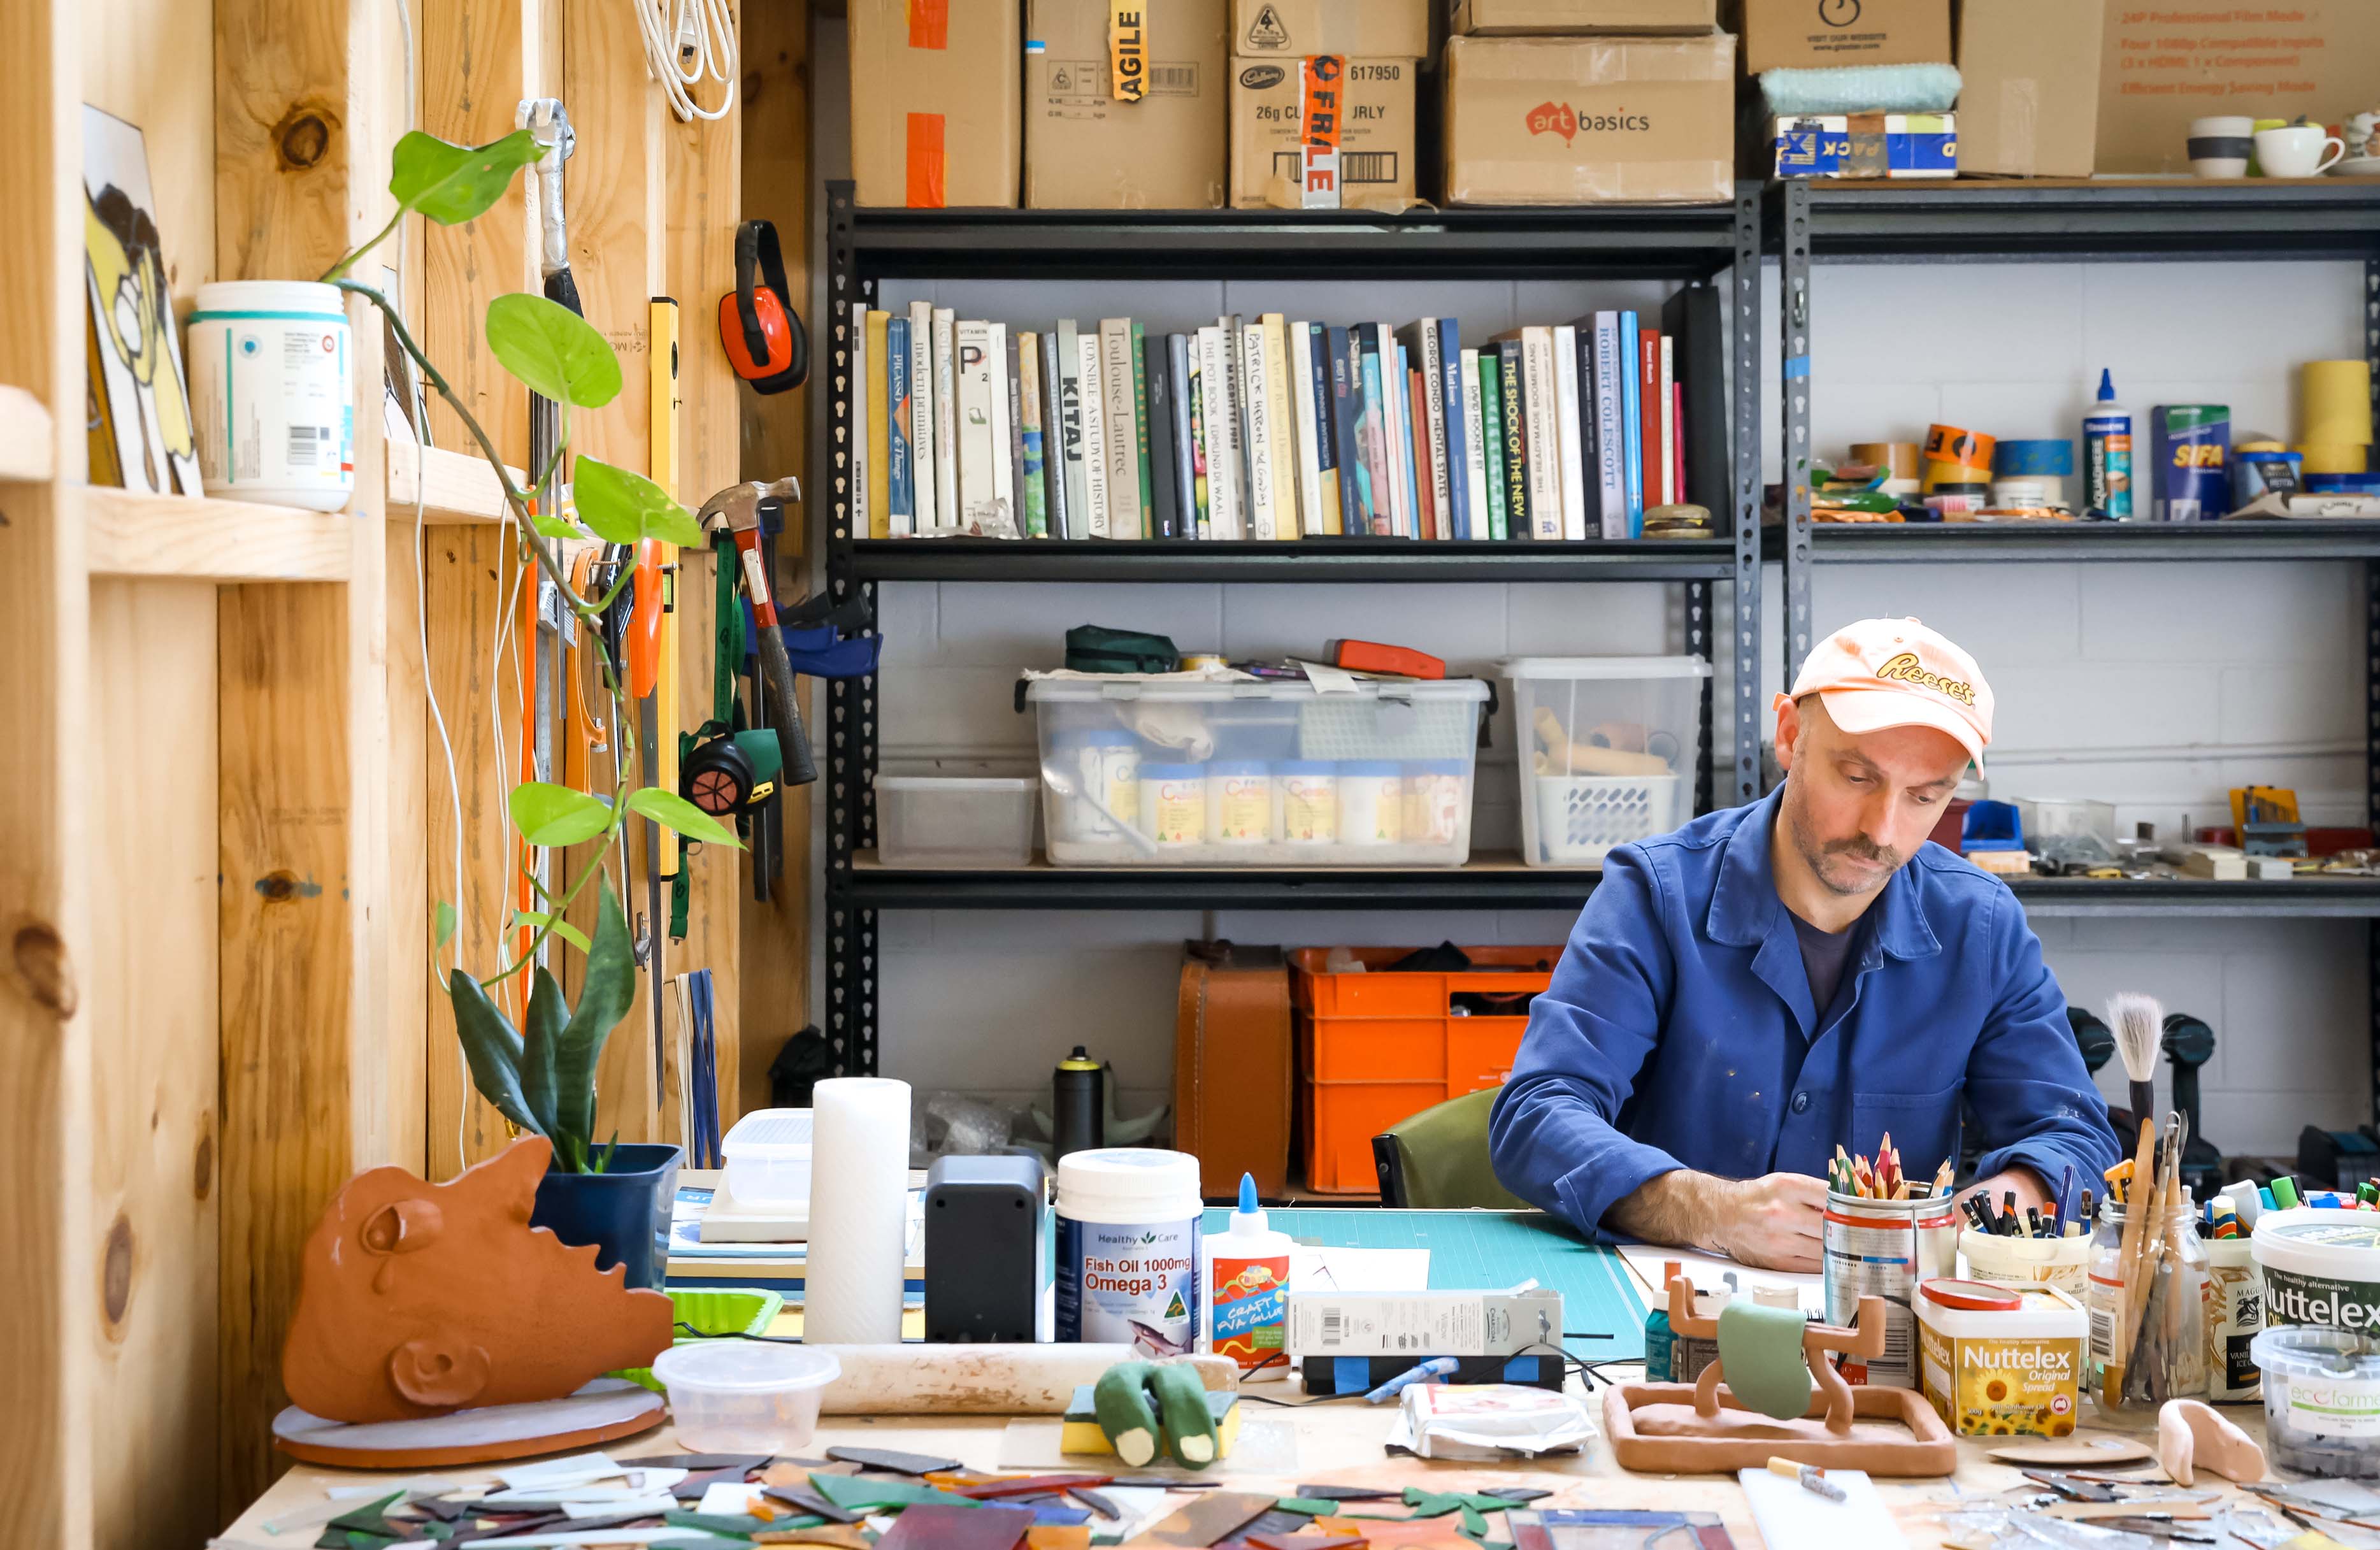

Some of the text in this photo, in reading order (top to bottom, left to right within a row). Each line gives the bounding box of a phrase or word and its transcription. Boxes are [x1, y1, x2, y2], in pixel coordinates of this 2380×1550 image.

[2150, 11, 2232, 24] Professional
[2233, 10, 2263, 22] Film
[2265, 10, 2305, 22] Mode
[1850, 32, 1886, 41] WEBSITE
[2121, 38, 2151, 50] Four
[2199, 37, 2278, 50] Compatible
[2281, 37, 2325, 49] Inputs
[1350, 66, 1400, 80] 617950
[2120, 81, 2316, 96] Efficient Energy Saving Mode
[1256, 106, 1280, 122] 26g
[1534, 106, 1650, 131] art basics
[1823, 140, 1879, 157] PACK
[959, 346, 982, 375] P
[1426, 326, 1438, 369] GEORGE
[1084, 340, 1097, 397] TOYNBEE
[1248, 333, 1263, 395] PATRICK
[1335, 358, 1347, 398] every day
[1503, 361, 1517, 388] THE
[913, 342, 929, 460] modern primitives
[1108, 327, 1129, 478] Toulouse-Lautrec
[1226, 363, 1238, 424] MAGRITTE
[1430, 373, 1441, 413] CONDO
[1471, 385, 1480, 412] DAVID
[891, 354, 904, 480] PICASSO & Things
[1063, 377, 1082, 462] KITAJ
[1252, 401, 1265, 444] HERON
[1505, 389, 1521, 435] SHOCK
[1529, 343, 1544, 494] THE READYMADE BOOMERANG
[1599, 327, 1616, 490] ROBERT COLESCOTT
[1089, 415, 1101, 457] STUDY
[1206, 341, 1226, 517] THE POT BOOK EDMUND DE WAAL
[1433, 417, 1445, 459] MENTAL
[1472, 414, 1482, 456] HOCKNEY
[1508, 436, 1522, 455] OF
[2172, 443, 2224, 468] SIFA
[1091, 459, 1102, 476] OF
[1436, 463, 1448, 499] STATES
[1510, 457, 1524, 482] THE
[2091, 438, 2105, 510] AQUADHERE
[1092, 478, 1106, 531] HISTORY
[1511, 484, 1525, 517] NEW
[1876, 652, 1975, 706] Reese's
[1098, 1233, 1179, 1245] Healthy Care
[1085, 1257, 1191, 1273] Fish Oil 1000mg
[1085, 1273, 1167, 1296] Omega 3
[2273, 1270, 2350, 1292] The healthy alternative
[1228, 1296, 1273, 1320] CRAFT
[2262, 1276, 2380, 1329] Nuttelex
[1217, 1305, 1283, 1333] PVA GLUE
[1921, 1327, 1951, 1368] Nuttelex
[1964, 1345, 2070, 1370] Nuttelex
[2230, 1351, 2251, 1360] VANIL
[2028, 1370, 2070, 1383] Original
[2236, 1360, 2246, 1368] ICE
[2023, 1382, 2055, 1394] Spread
[1967, 1407, 1982, 1416] 500g
